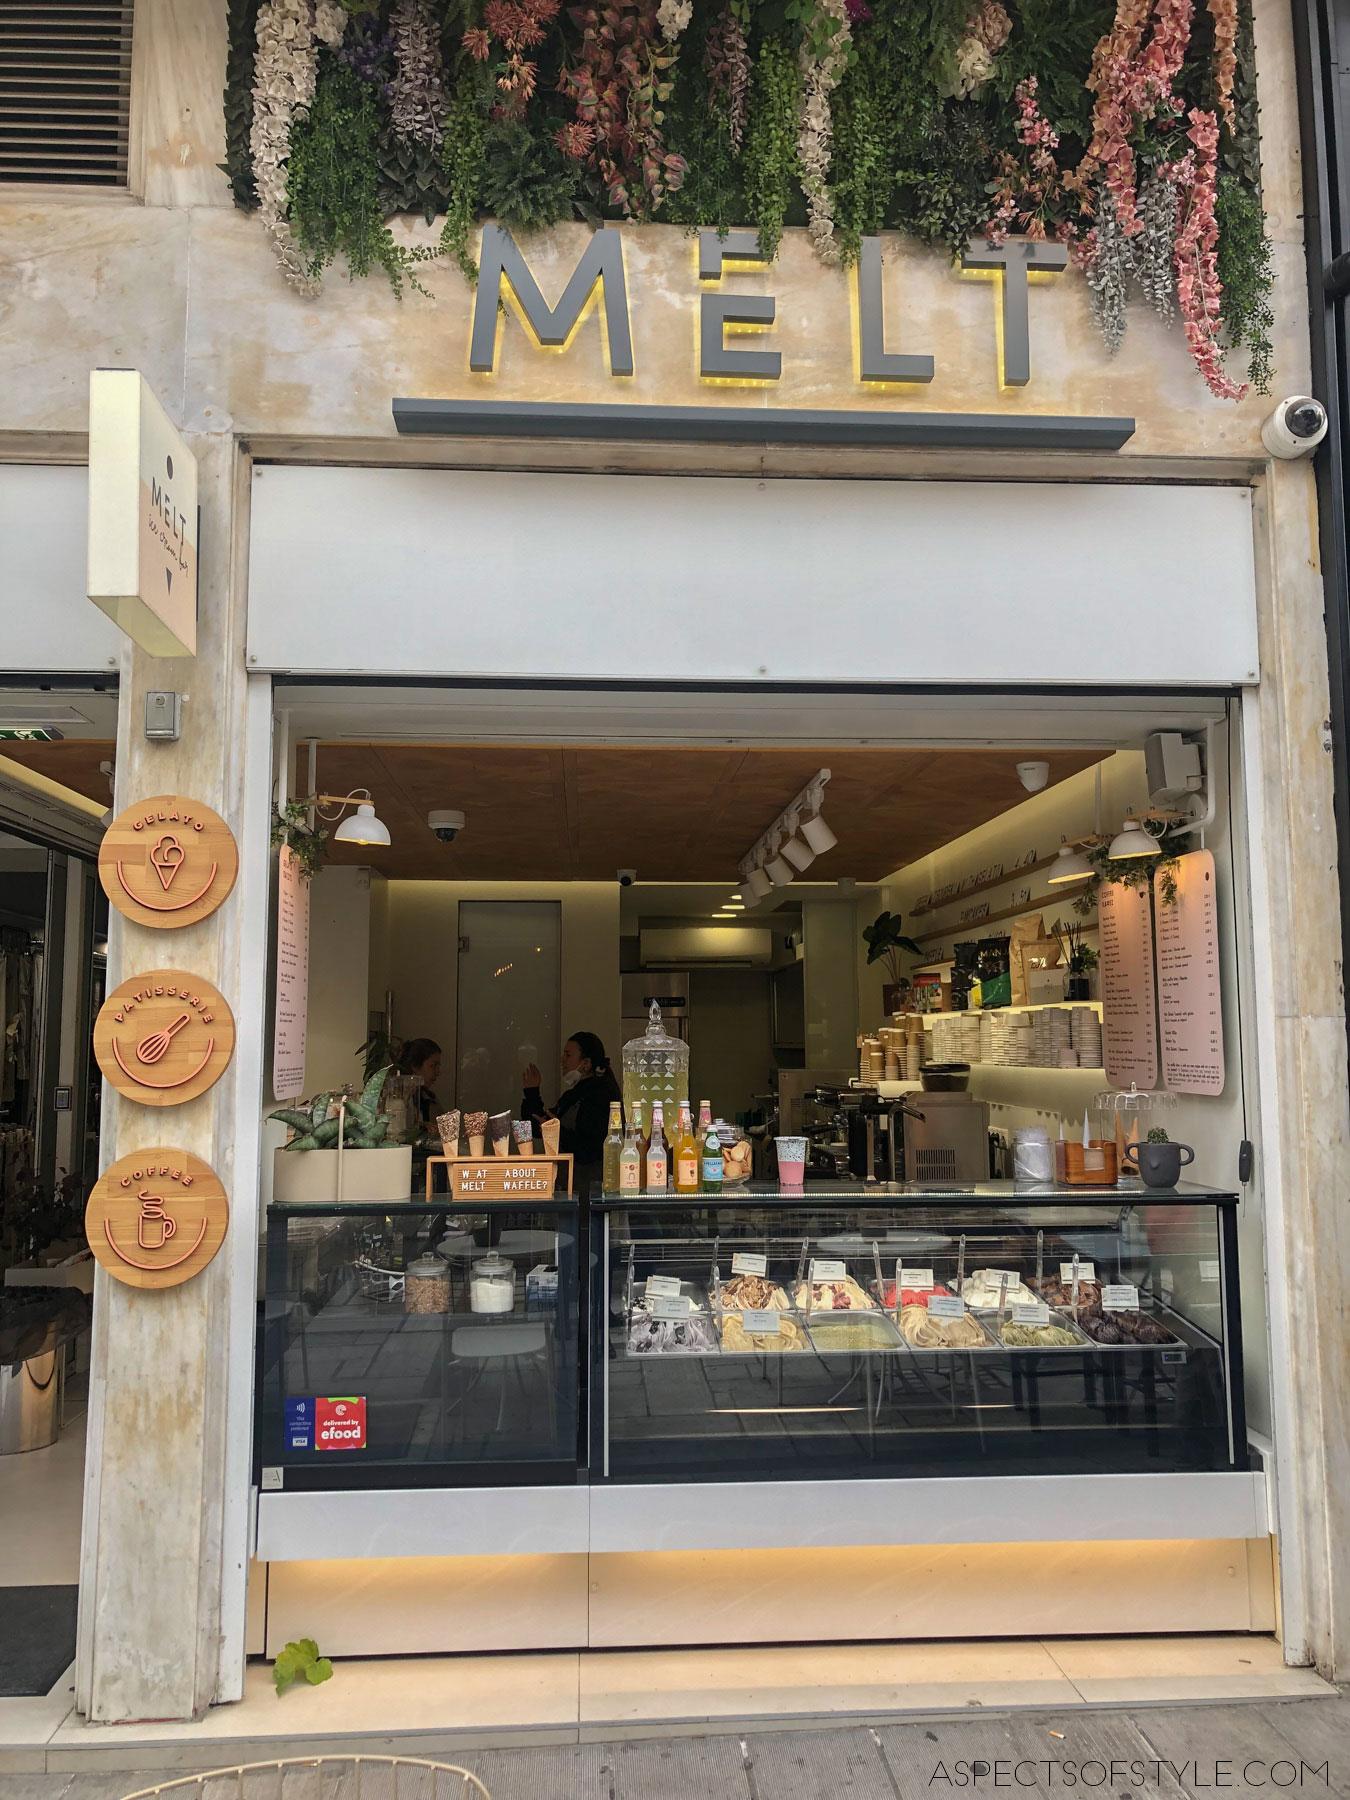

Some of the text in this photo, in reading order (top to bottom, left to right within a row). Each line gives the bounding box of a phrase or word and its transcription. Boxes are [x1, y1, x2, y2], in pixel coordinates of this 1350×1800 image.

[468, 224, 1069, 388] MELT
[151, 476, 187, 543] MELT
[132, 811, 205, 833] GELATO
[114, 984, 215, 1024] PATISSERIE
[120, 1166, 194, 1188] COFFEE
[504, 1168, 537, 1178] ABOUT
[461, 1180, 548, 1191] MELT WAFFLE?
[321, 1426, 361, 1440] efood
[351, 1419, 359, 1427] by
